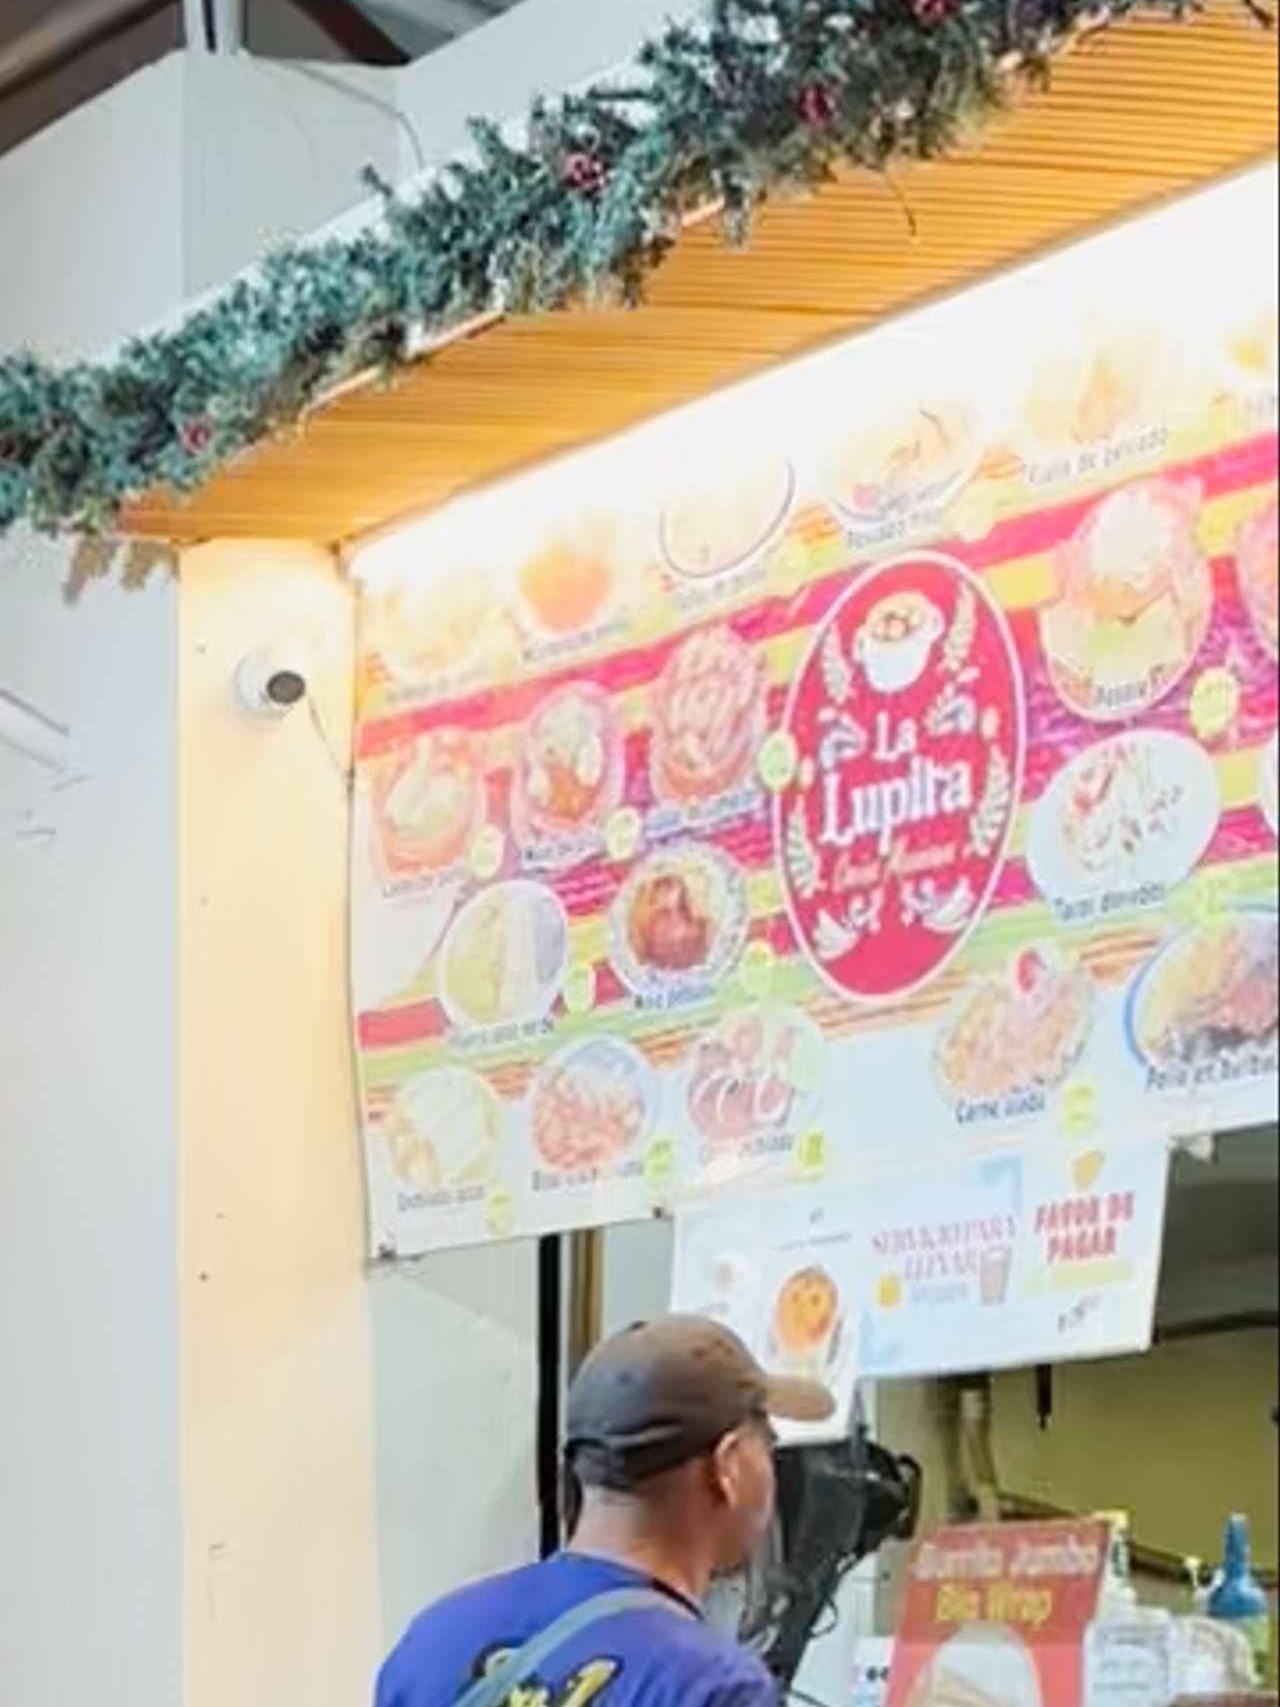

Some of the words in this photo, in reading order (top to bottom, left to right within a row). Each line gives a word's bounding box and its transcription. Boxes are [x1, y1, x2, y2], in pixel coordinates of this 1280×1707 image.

[872, 709, 918, 761] La
[819, 755, 972, 857] Lupita
[1033, 1196, 1100, 1236] FAVOR
[1107, 1191, 1136, 1222] DE
[1047, 1226, 1117, 1265] PAGAR
[1009, 1533, 1099, 1577] Jumbo
